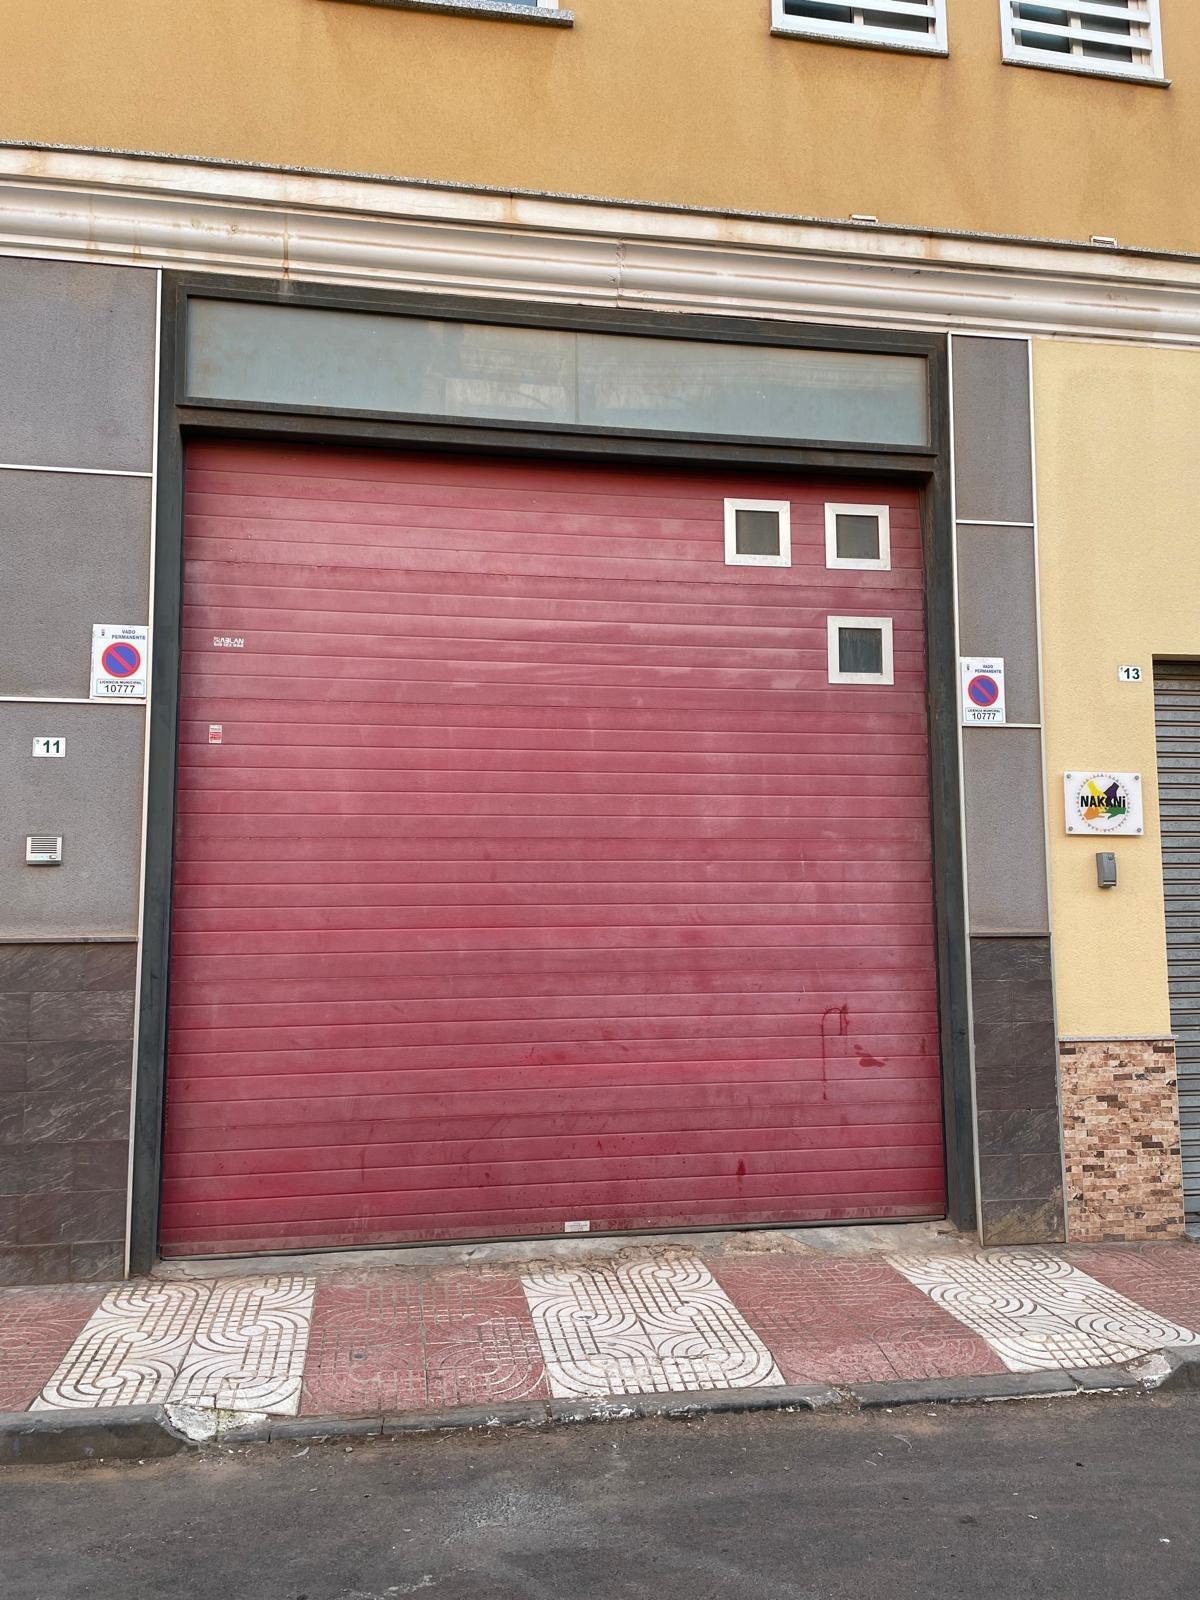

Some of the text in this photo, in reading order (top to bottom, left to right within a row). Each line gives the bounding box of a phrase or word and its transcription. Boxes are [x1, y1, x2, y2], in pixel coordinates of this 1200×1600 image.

[1123, 667, 1140, 680] 13
[104, 684, 136, 693] 10777
[972, 712, 997, 720] 10777
[43, 739, 60, 753] 11
